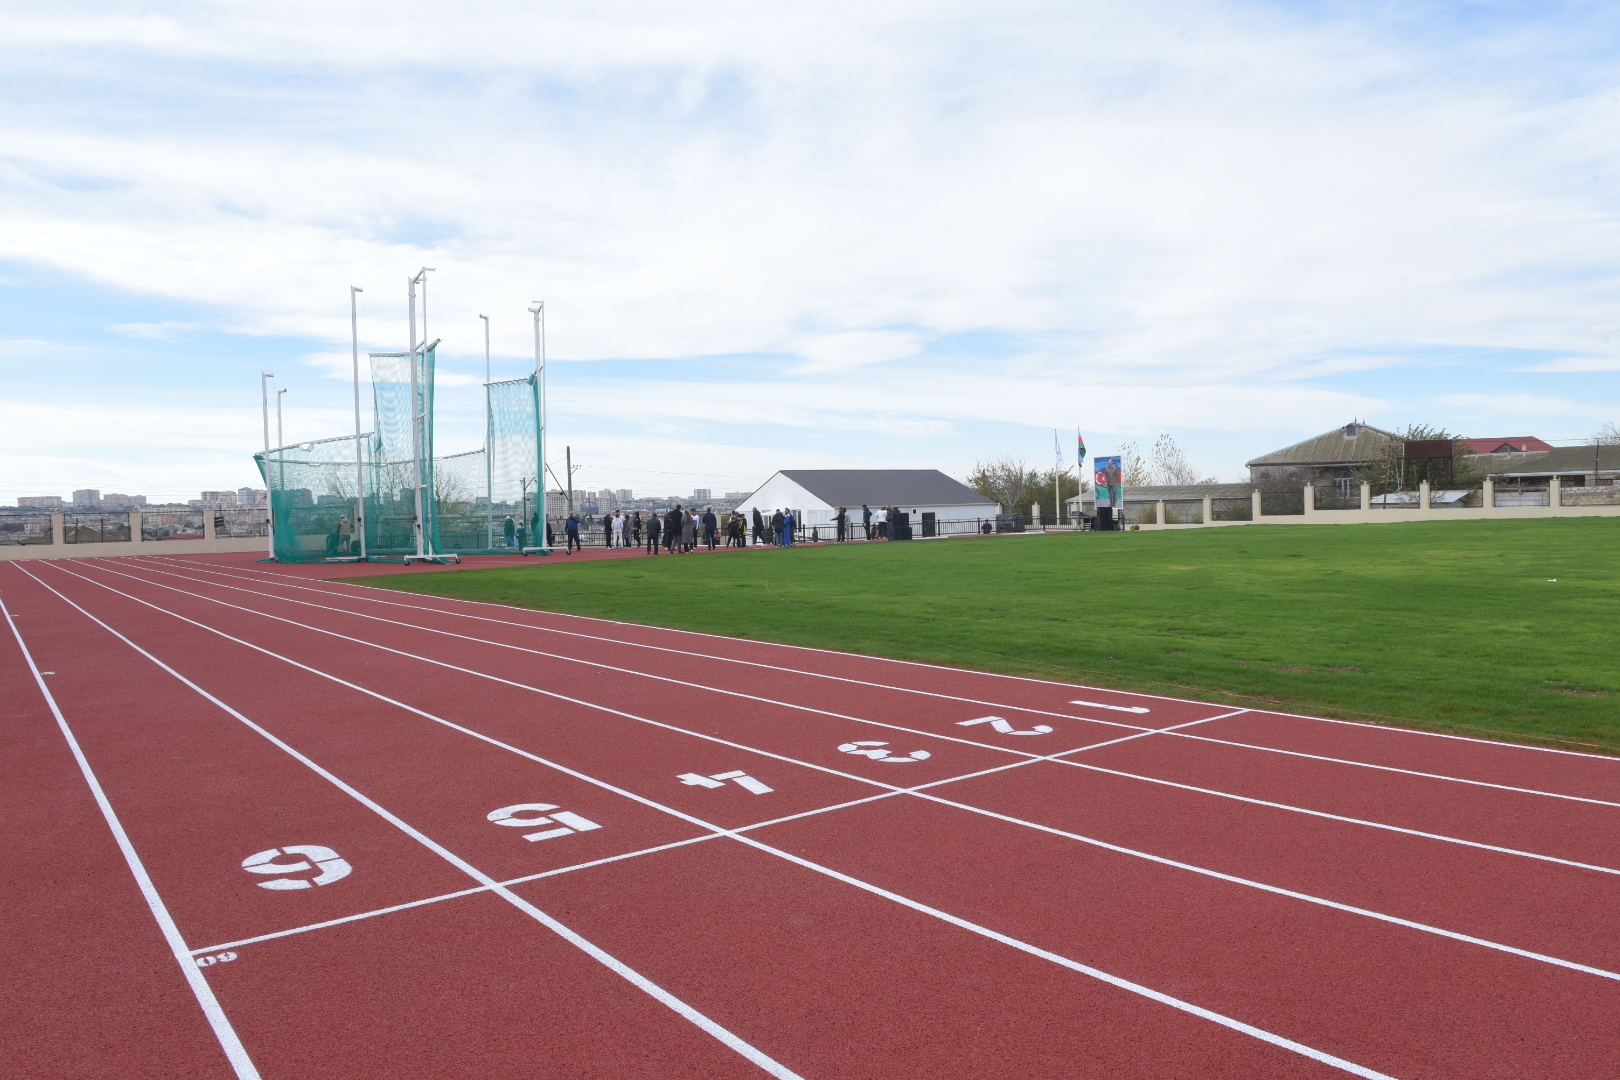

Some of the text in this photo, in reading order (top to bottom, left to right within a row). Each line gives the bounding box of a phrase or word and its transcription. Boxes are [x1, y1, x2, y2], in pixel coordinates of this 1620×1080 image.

[1068, 700, 1151, 714] 1
[957, 715, 1054, 736] 2
[837, 741, 932, 763] 3
[676, 769, 775, 796] 4
[485, 802, 603, 843] 5
[241, 844, 353, 890] 6
